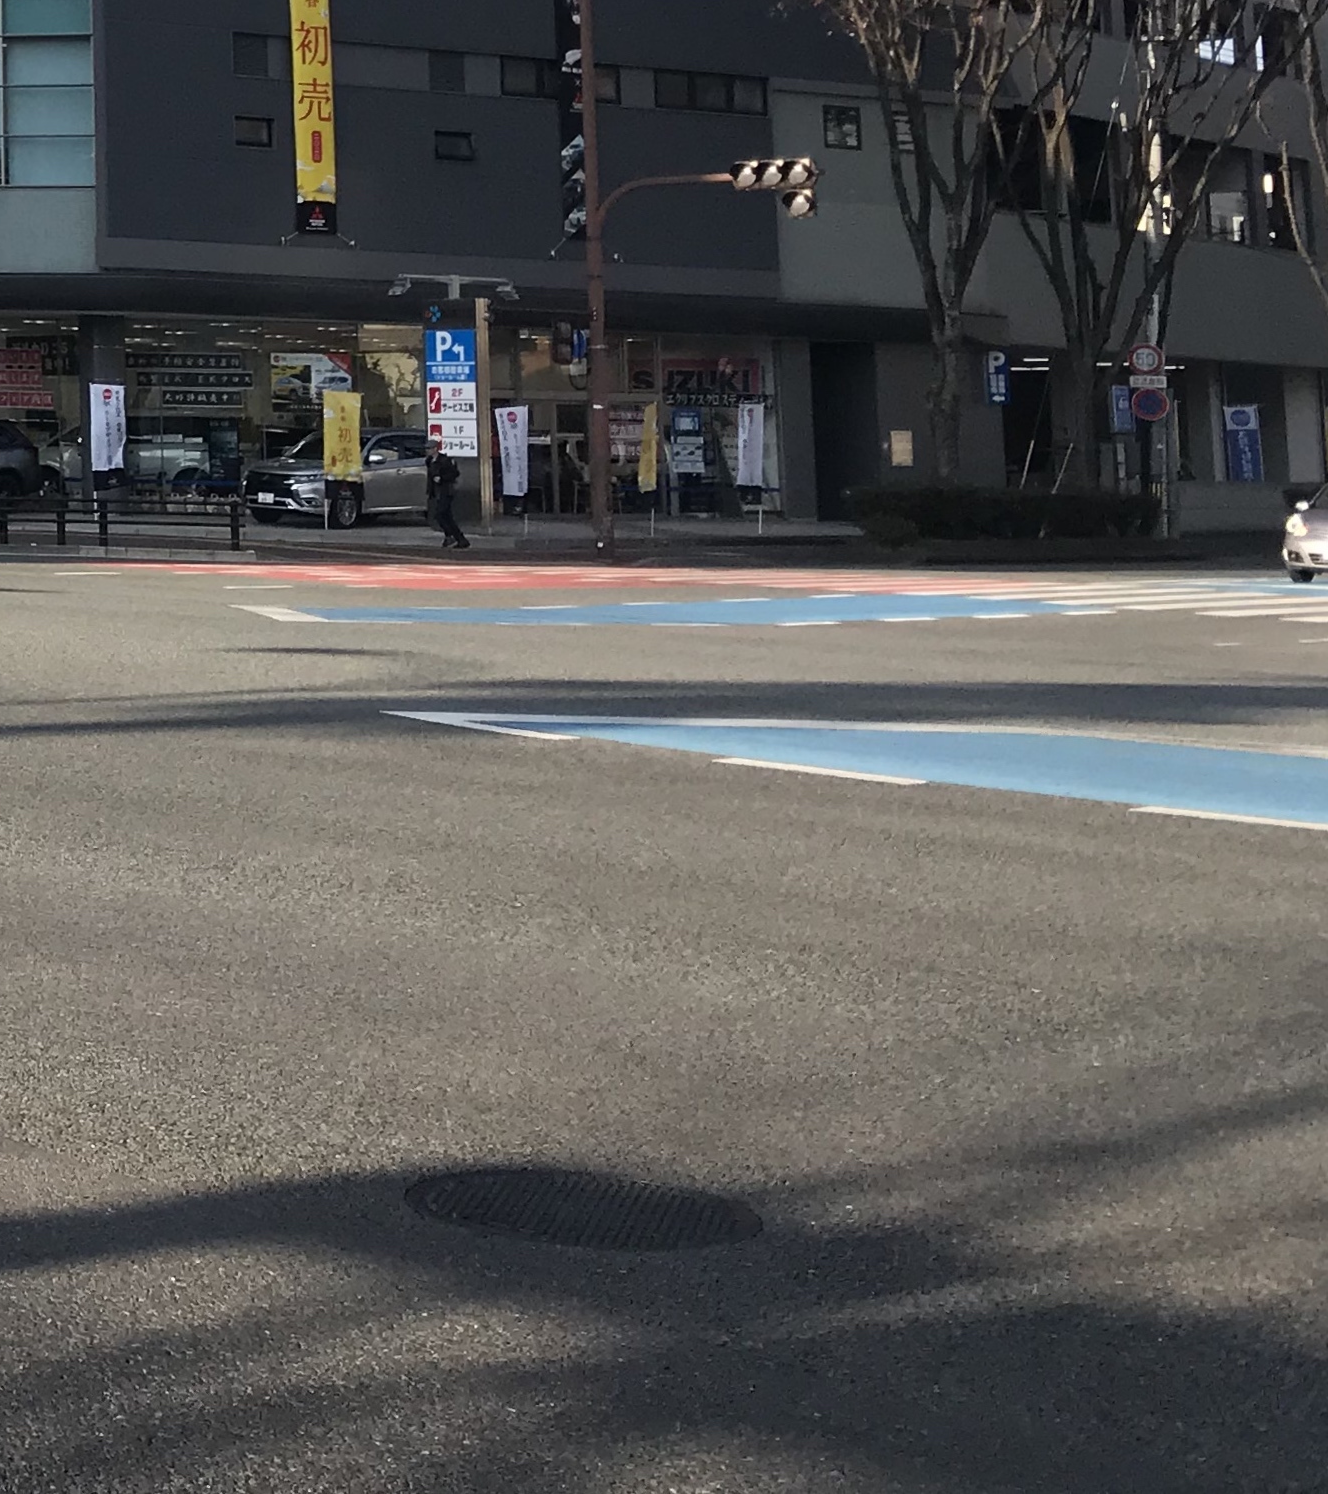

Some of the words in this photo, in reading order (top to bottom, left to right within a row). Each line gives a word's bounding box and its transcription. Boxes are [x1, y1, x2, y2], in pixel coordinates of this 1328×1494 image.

[294, 20, 332, 122] 初売
[435, 331, 453, 362] P
[988, 350, 1006, 374] P
[1135, 351, 1157, 367] 50
[451, 388, 464, 398] 2F
[452, 425, 465, 435] 1F
[442, 440, 476, 451] ショールーム
